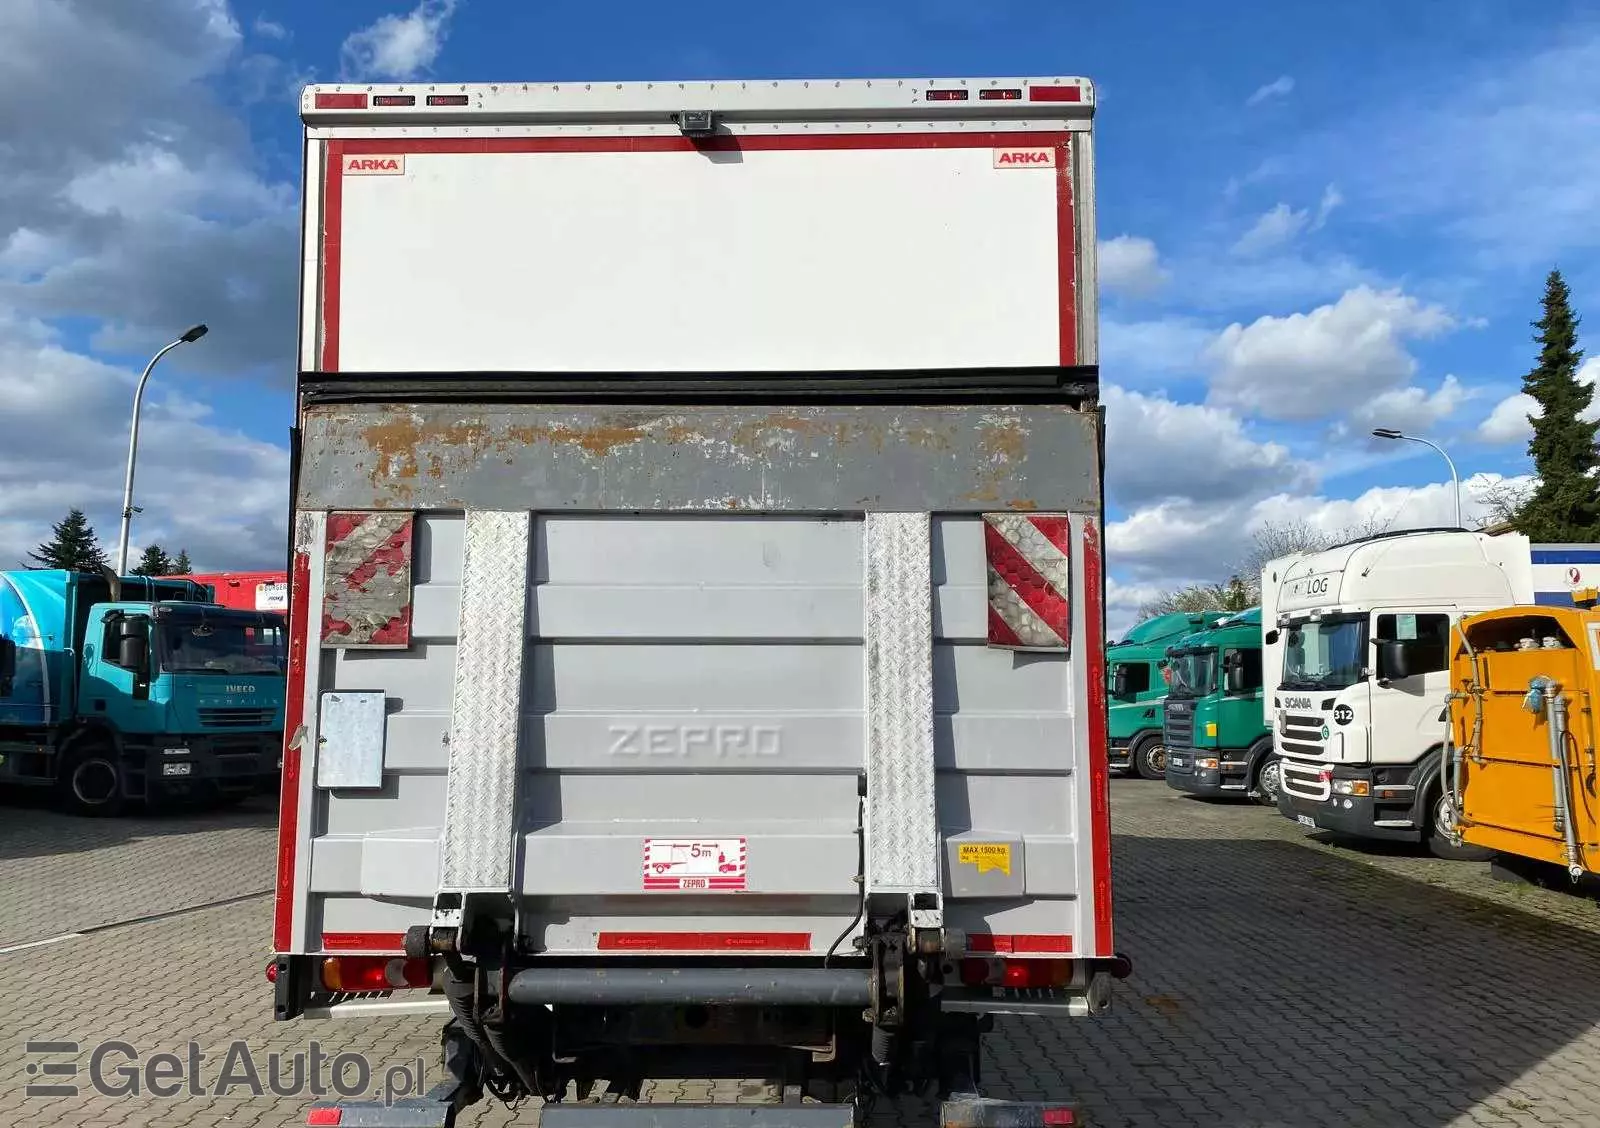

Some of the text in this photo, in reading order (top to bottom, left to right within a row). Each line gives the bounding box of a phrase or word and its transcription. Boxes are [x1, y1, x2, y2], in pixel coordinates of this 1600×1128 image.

[998, 152, 1050, 163] ARKA
[348, 159, 399, 170] ARKA
[1307, 577, 1329, 594] LOG
[1285, 697, 1312, 709] SCANIA
[1334, 710, 1353, 720] 312
[608, 725, 783, 758] ZEPRO
[996, 847, 1006, 855] kg
[683, 879, 706, 888] ZEPRO
